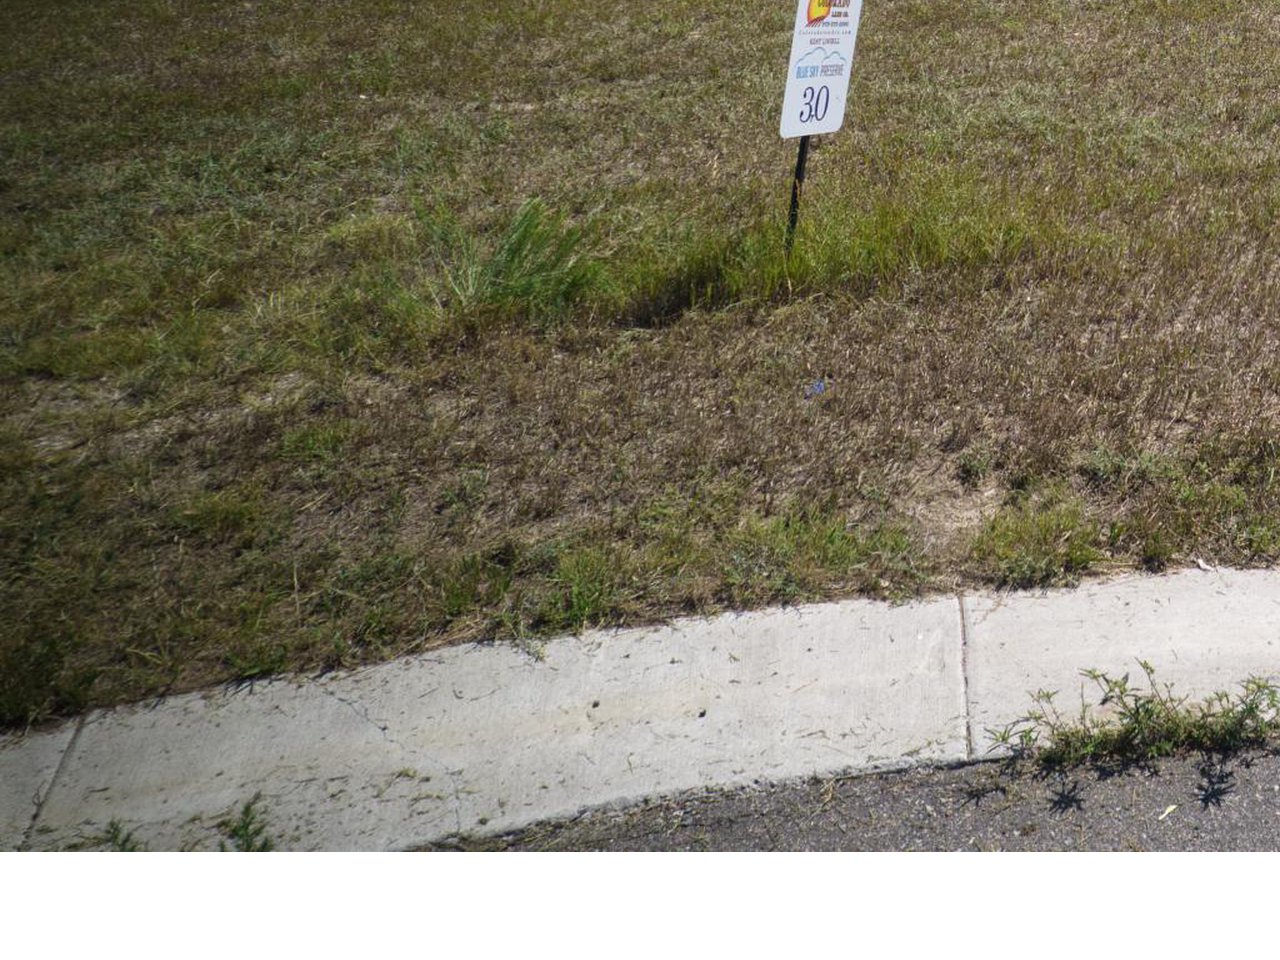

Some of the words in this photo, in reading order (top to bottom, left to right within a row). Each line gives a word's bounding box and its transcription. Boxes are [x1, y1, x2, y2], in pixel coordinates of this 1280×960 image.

[796, 66, 809, 79] BLUE
[809, 65, 820, 78] SKY
[819, 64, 844, 78] PRESERVE
[799, 85, 830, 123] 30
